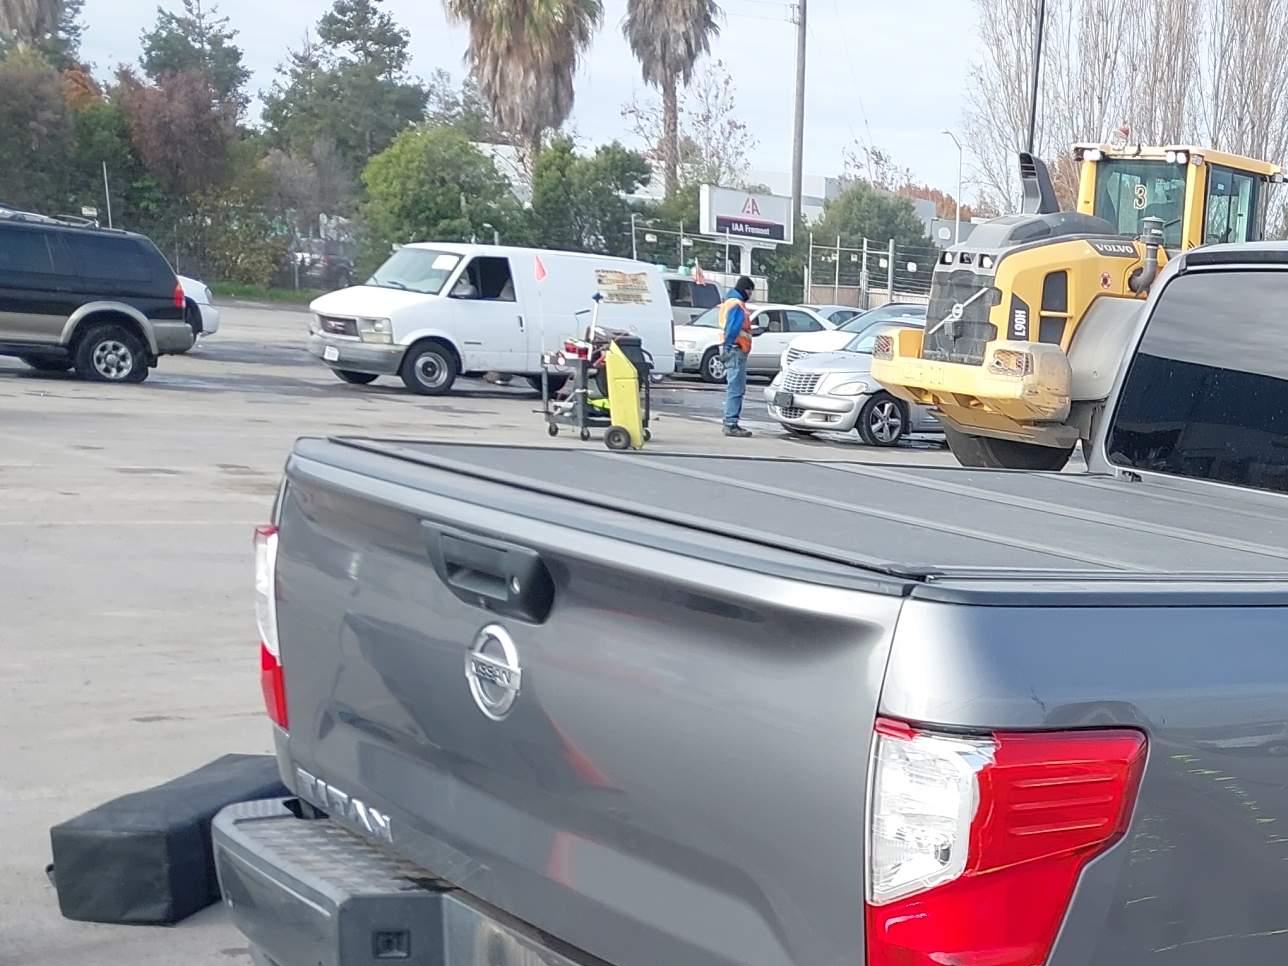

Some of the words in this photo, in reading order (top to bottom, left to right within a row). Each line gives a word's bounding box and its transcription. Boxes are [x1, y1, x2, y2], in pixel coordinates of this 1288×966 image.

[1133, 185, 1147, 209] 3
[731, 222, 744, 232] IAA
[1095, 244, 1134, 254] VOLVO
[1014, 309, 1027, 337] L90H
[471, 660, 512, 686] NISSAN
[297, 767, 393, 844] TITAN
